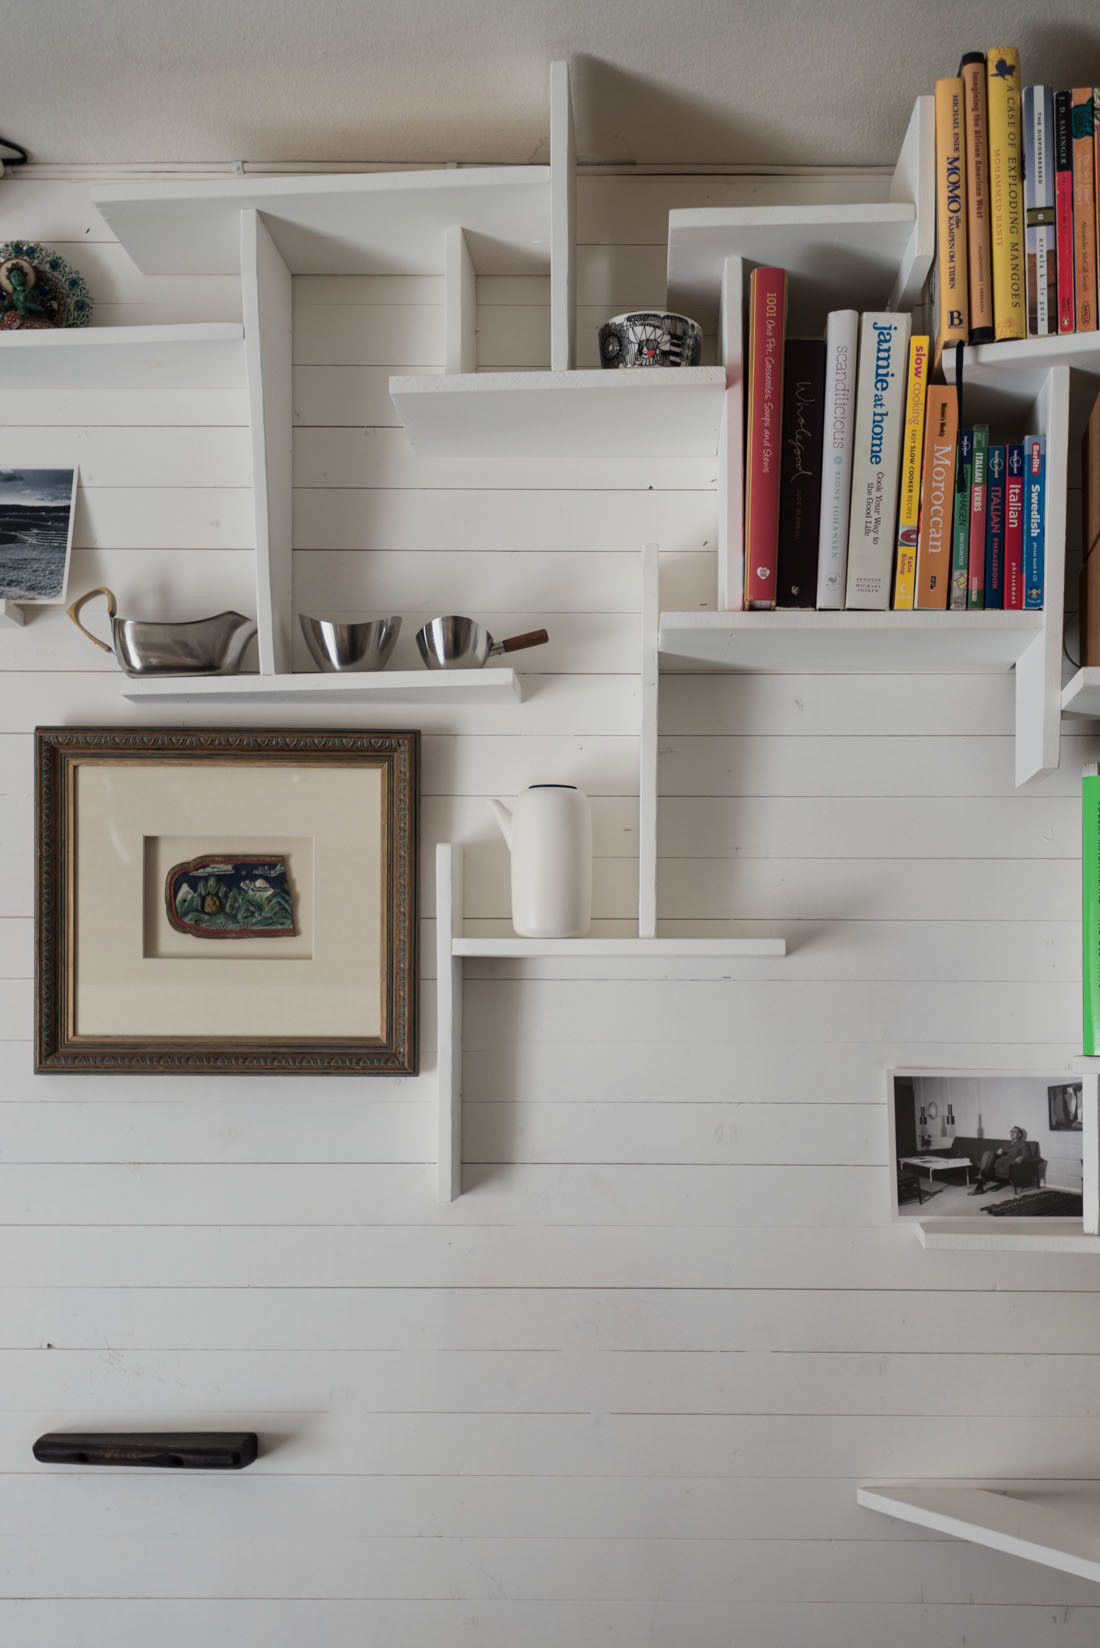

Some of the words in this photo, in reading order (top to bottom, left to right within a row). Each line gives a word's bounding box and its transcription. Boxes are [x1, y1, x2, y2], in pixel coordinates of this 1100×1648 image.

[971, 72, 981, 112] Imagining
[1007, 85, 1015, 93] A
[952, 95, 961, 129] MICHAEL
[1007, 97, 1017, 128] CASE
[952, 132, 960, 153] ENDE
[974, 130, 982, 157] African
[1008, 132, 1017, 149] OF
[946, 156, 962, 214] MOMO
[975, 160, 984, 197] American
[994, 149, 1003, 212] MOHAMMED
[976, 199, 985, 219] West
[1008, 157, 1019, 234] EXPLODING
[948, 216, 957, 249] KAMPEN
[948, 251, 956, 263] OM
[1039, 238, 1047, 269] ursula
[1010, 242, 1021, 309] MANGOES
[766, 292, 777, 317] 1001
[948, 310, 963, 327] B
[766, 319, 776, 336] One
[872, 322, 898, 391] jamie
[914, 345, 926, 378] slow
[833, 345, 850, 449] scandilicious
[873, 394, 886, 409] at
[908, 382, 923, 425] cooking
[761, 402, 774, 427] Soups
[763, 429, 773, 446] and
[788, 381, 816, 484] Wholefood
[870, 410, 888, 465] home
[762, 449, 773, 473] Stews
[974, 452, 984, 483] ITALIAN
[1032, 445, 1041, 473] Berlitz
[833, 470, 841, 500] SIGNE
[867, 482, 877, 496] the
[876, 471, 885, 493] Cook
[865, 497, 875, 518] Good
[875, 494, 883, 515] Your
[928, 444, 953, 555] Moroccan
[959, 472, 968, 526] NHAGEN
[973, 486, 983, 512] VERBS
[990, 487, 1002, 534] ITALIAN
[1009, 484, 1022, 528] Italian
[1031, 484, 1041, 536] Swedish
[832, 505, 841, 559] JOHANSEN
[864, 520, 873, 536] Life
[872, 517, 881, 534] Way
[873, 536, 880, 545] to
[899, 553, 908, 575] Bishop
